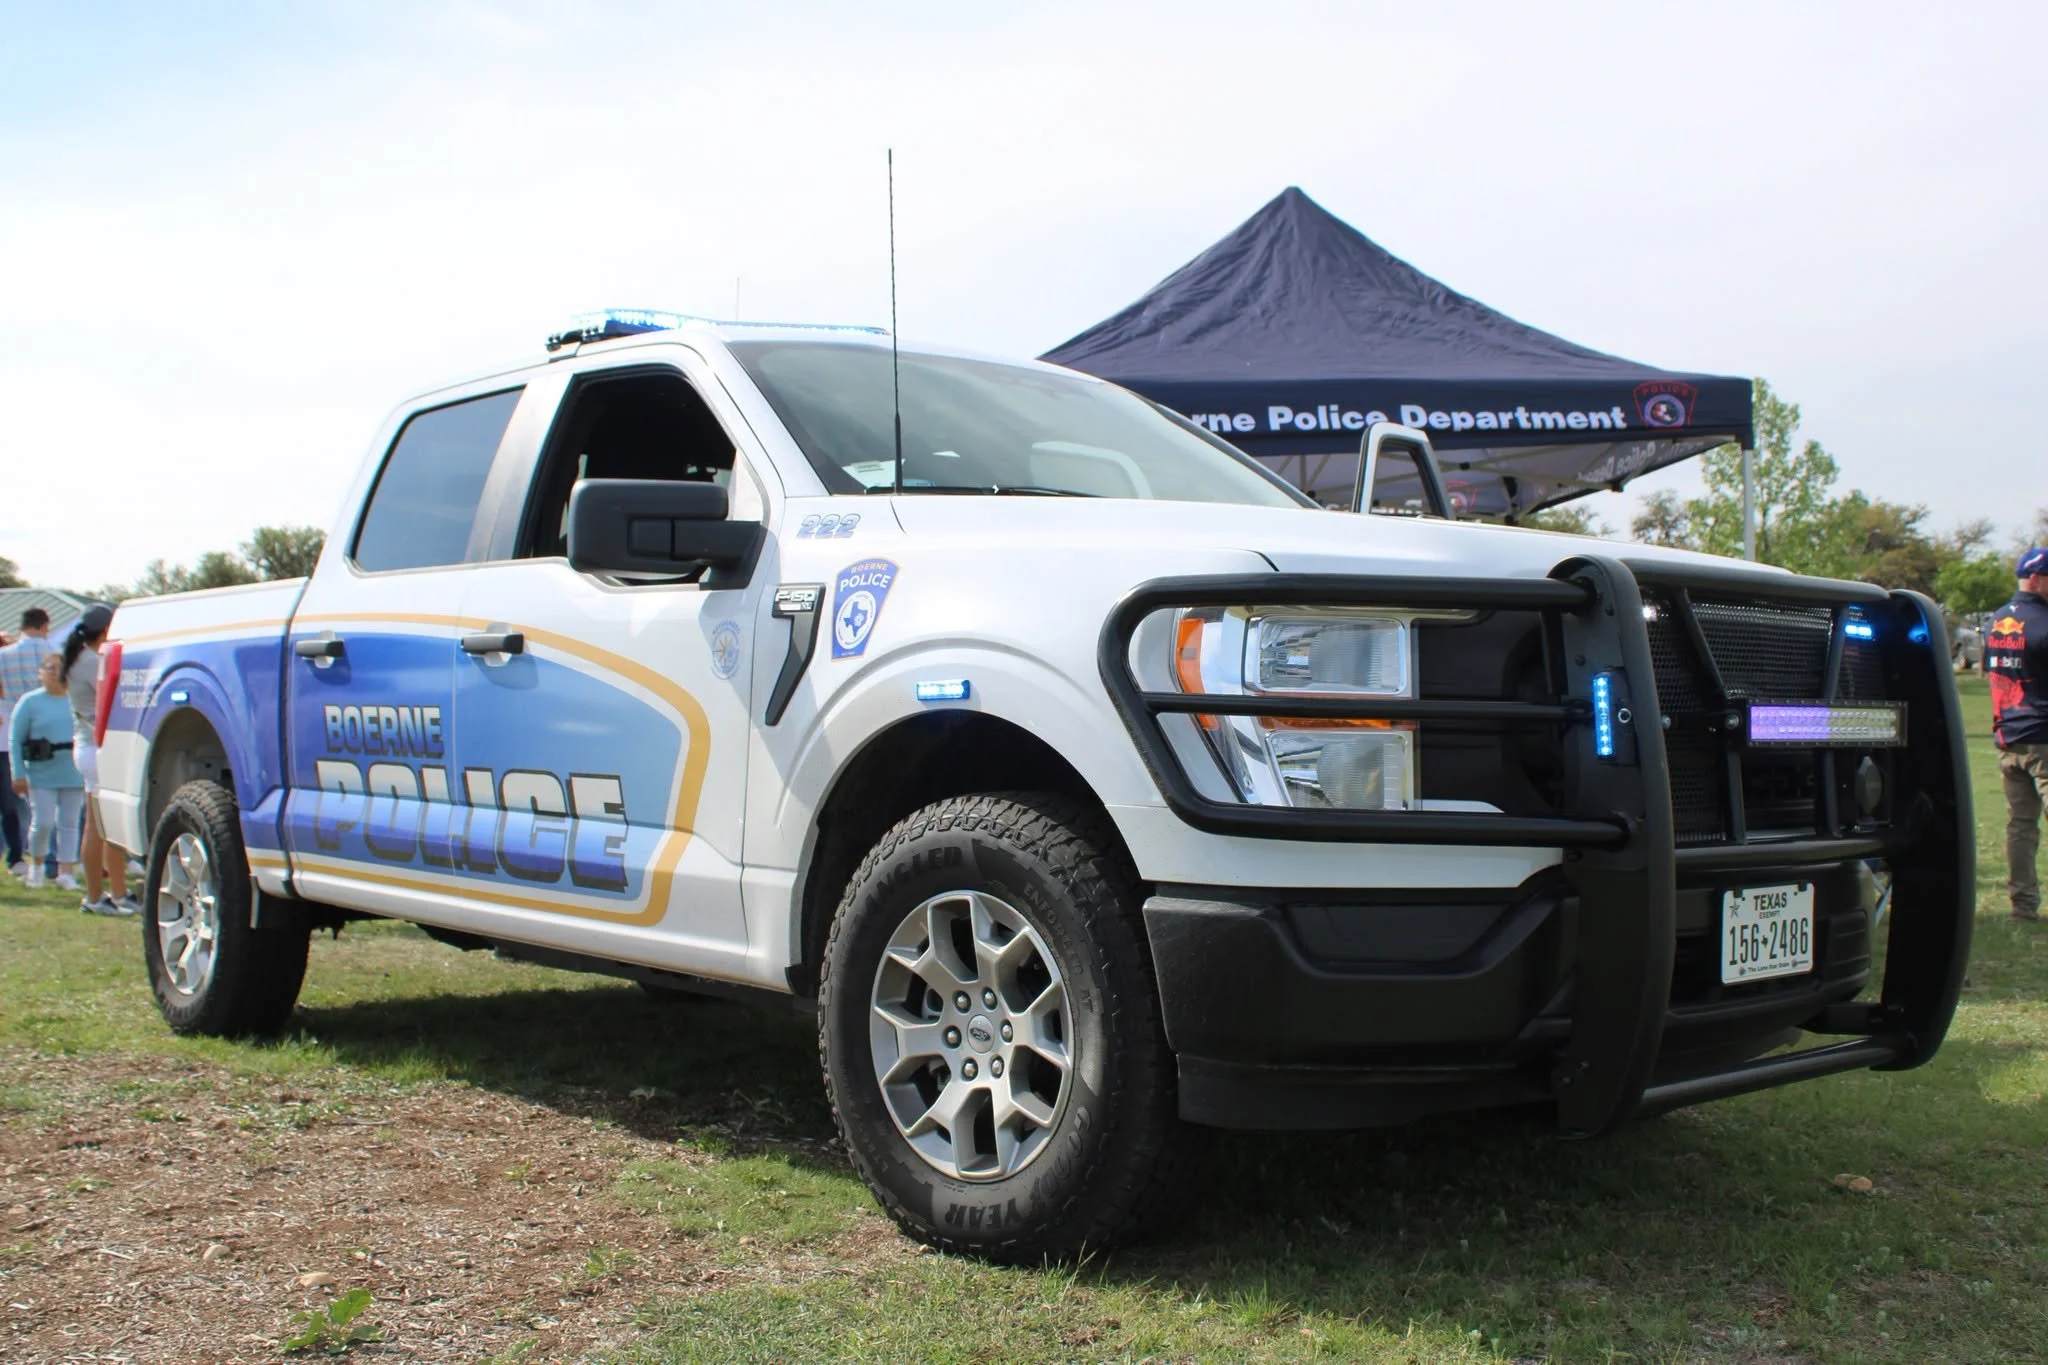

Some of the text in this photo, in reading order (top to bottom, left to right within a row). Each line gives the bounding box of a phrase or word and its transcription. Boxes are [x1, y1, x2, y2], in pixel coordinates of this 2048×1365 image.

[1190, 404, 1628, 433] rne Police Department
[797, 514, 861, 539] 222
[851, 562, 889, 574] BOERNE
[840, 573, 892, 592] POLICE
[324, 704, 445, 759] BOERNE
[313, 758, 629, 893] POLICE
[1753, 892, 1788, 911] TEXAS
[1759, 910, 1780, 919] EXEMPT
